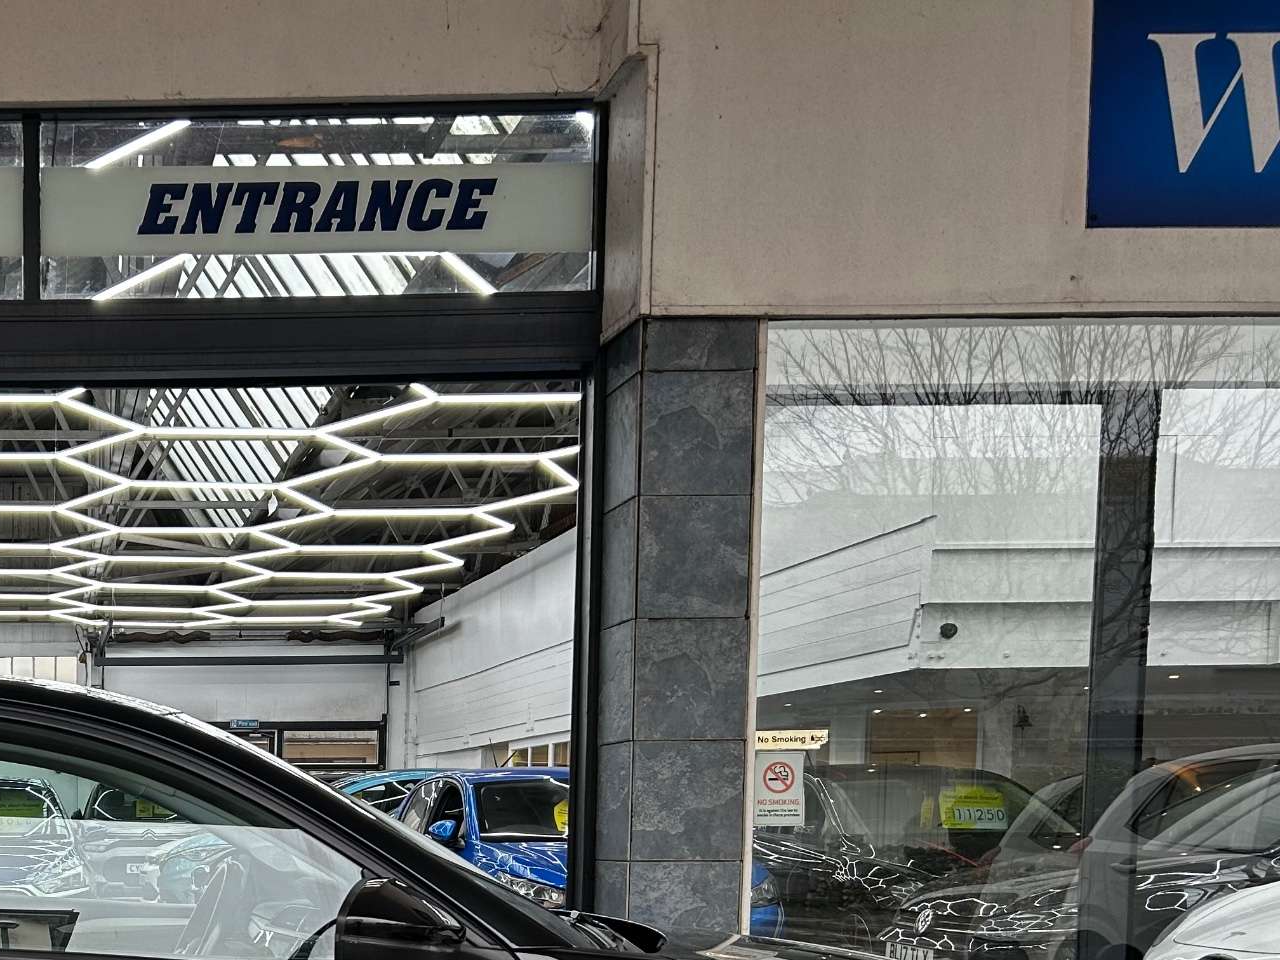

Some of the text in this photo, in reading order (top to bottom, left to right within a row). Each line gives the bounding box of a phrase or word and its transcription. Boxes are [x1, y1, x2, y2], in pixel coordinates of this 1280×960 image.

[137, 178, 498, 235] ENTRANCE
[771, 735, 806, 744] Smoking
[757, 798, 800, 806] NO SMOKING
